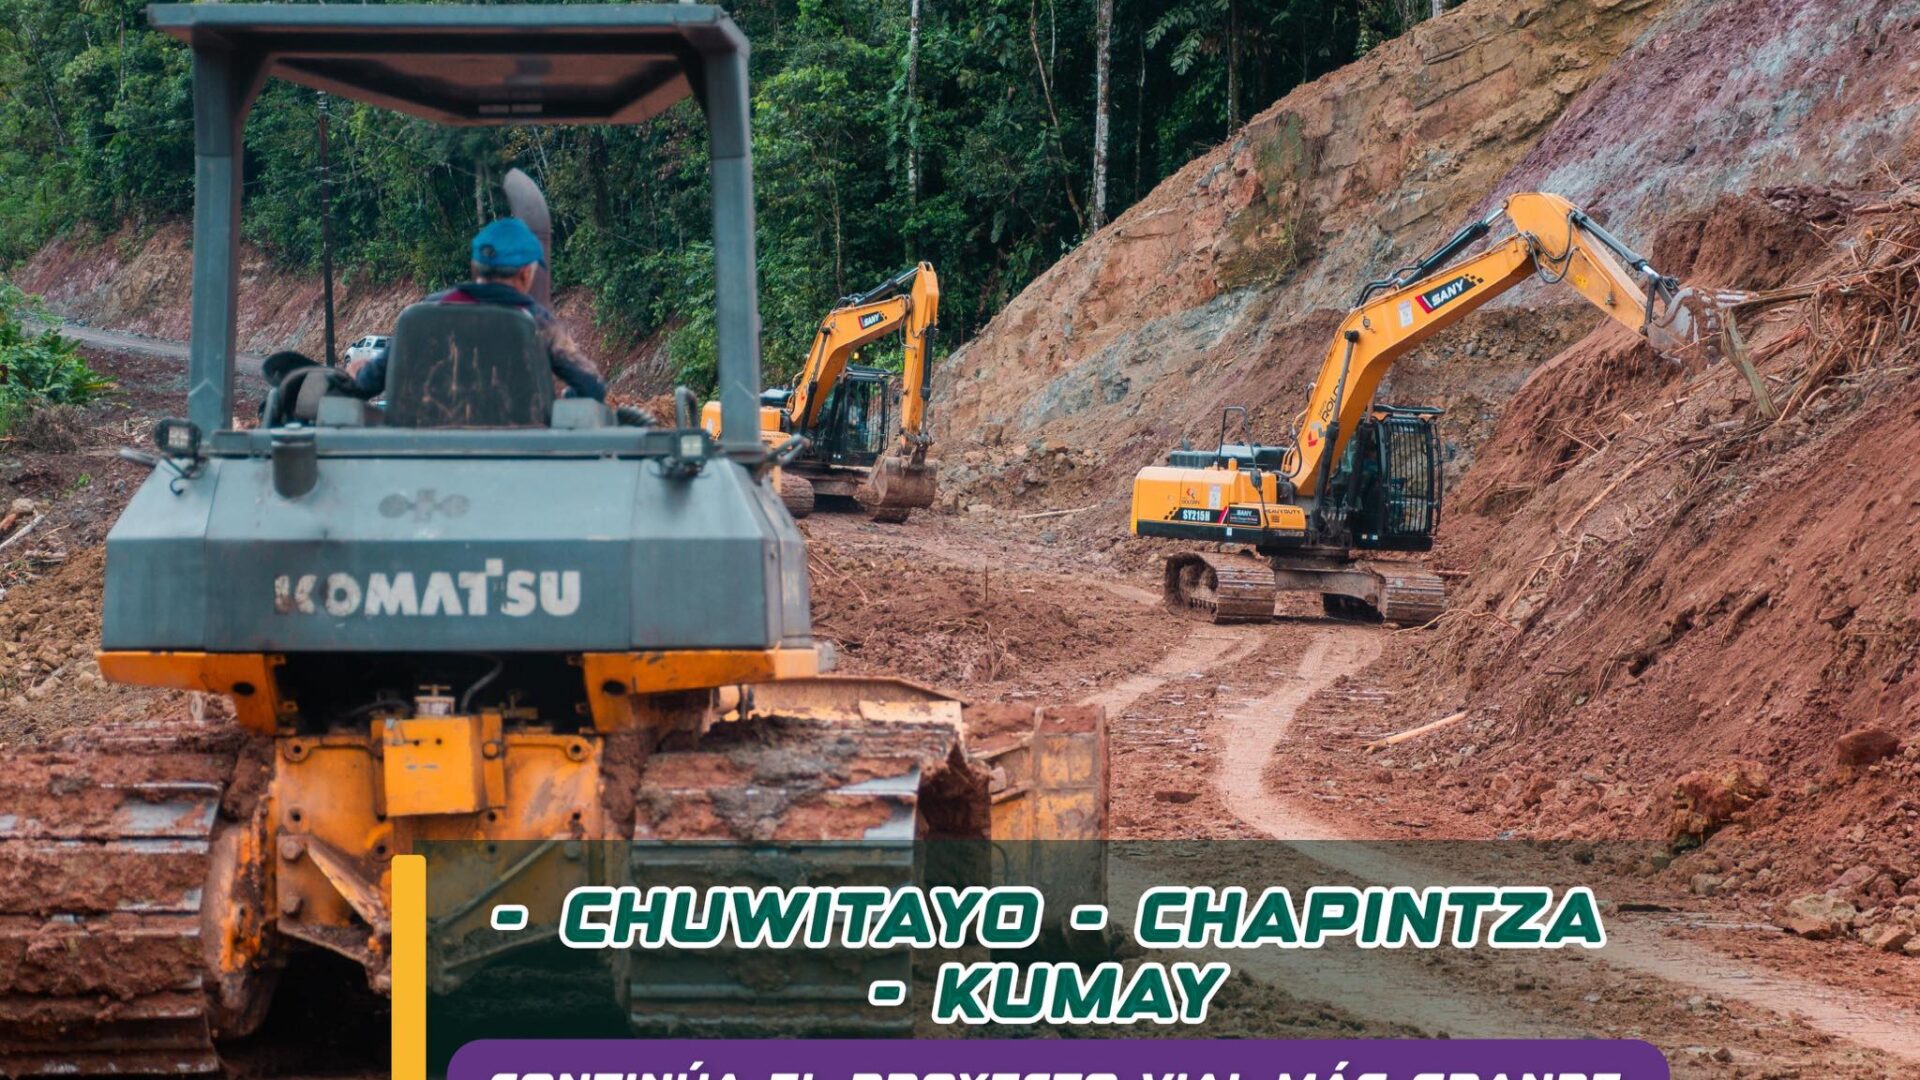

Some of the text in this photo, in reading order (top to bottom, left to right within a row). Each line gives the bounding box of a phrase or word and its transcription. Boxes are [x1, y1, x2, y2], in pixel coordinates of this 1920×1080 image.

[1431, 278, 1464, 307] SANY
[863, 313, 880, 327] SANY
[1182, 509, 1210, 522] SY215H
[274, 559, 581, 617] KOMATSU
